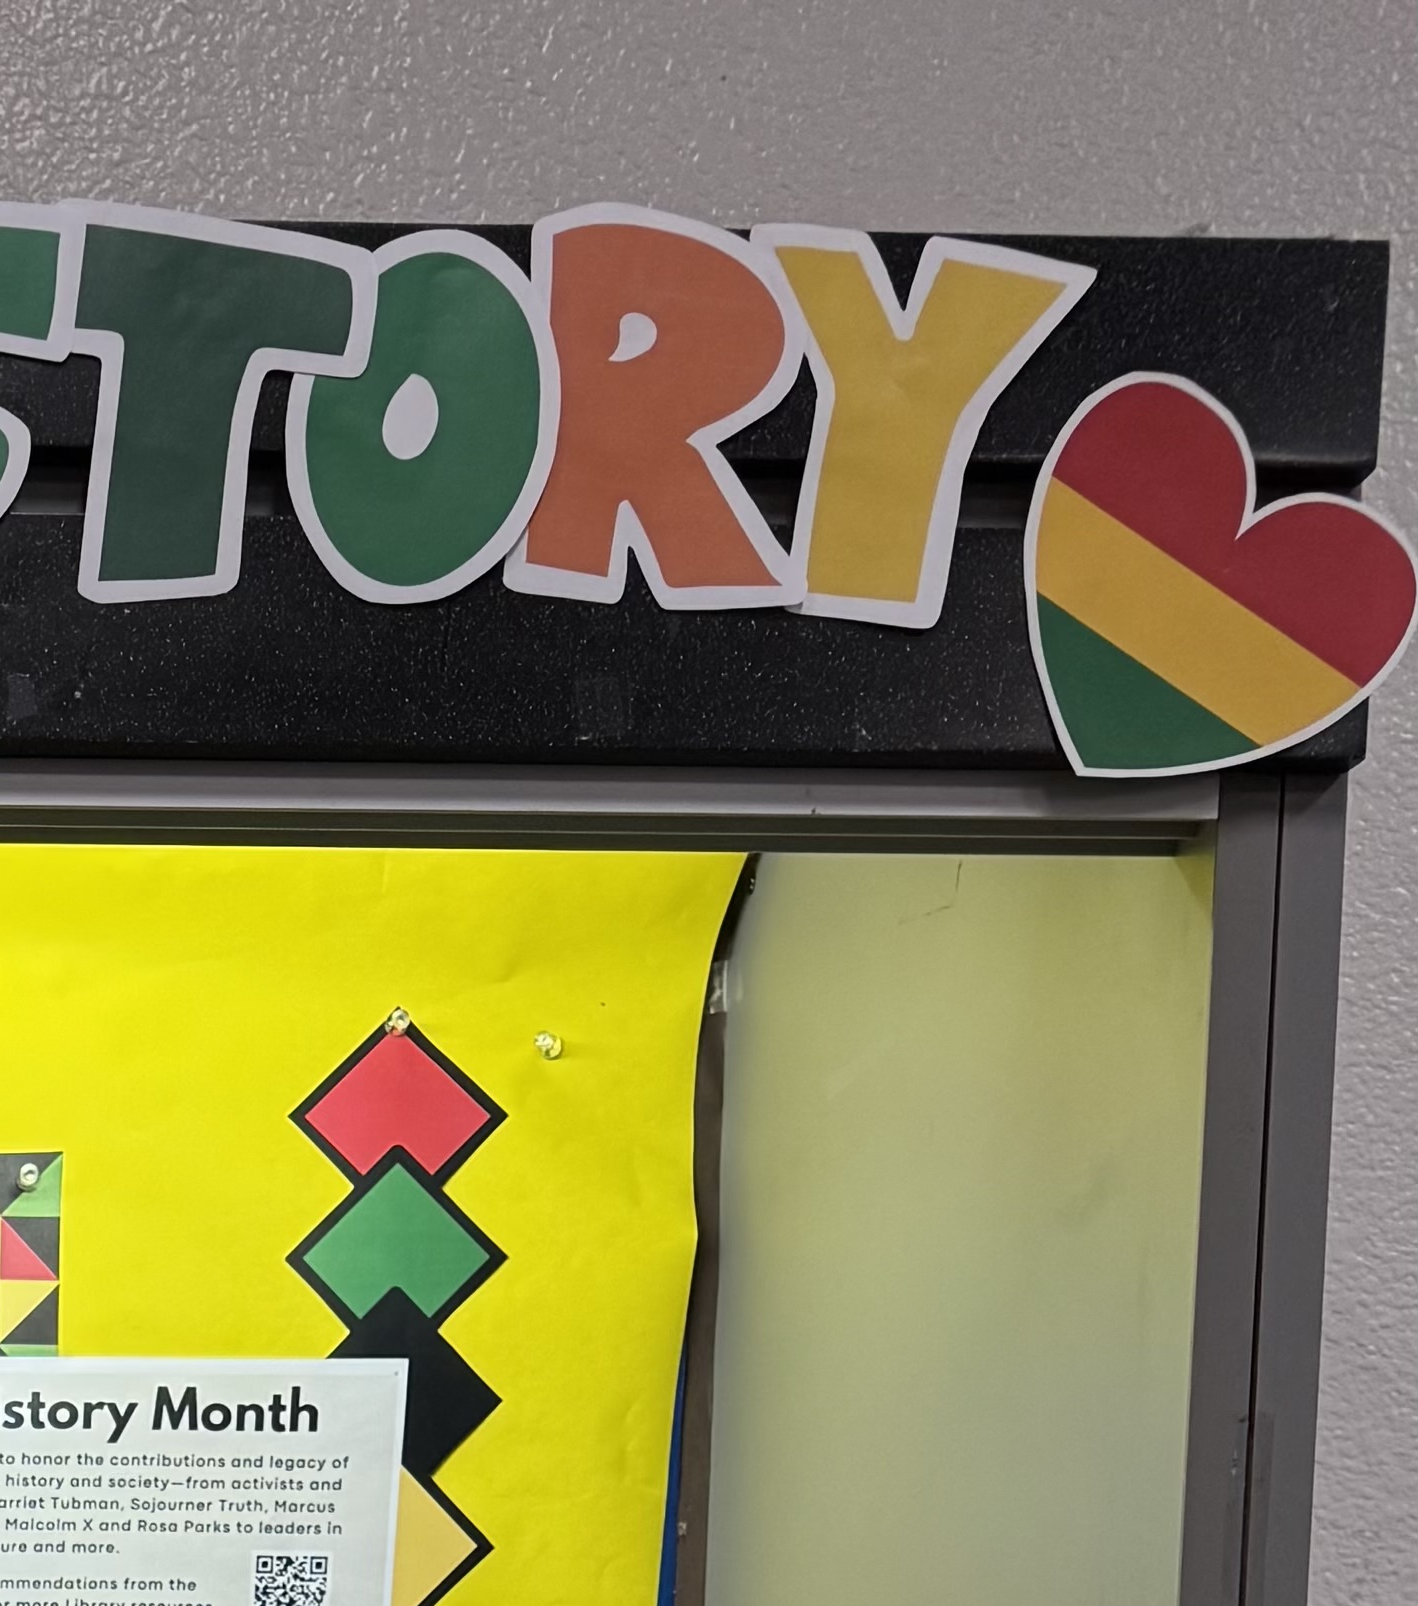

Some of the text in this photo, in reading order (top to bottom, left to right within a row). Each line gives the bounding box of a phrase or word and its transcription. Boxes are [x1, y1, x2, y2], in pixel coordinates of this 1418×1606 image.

[152, 1386, 318, 1433] Month
[21, 1452, 71, 1465] honor
[77, 1453, 104, 1466] the
[110, 1453, 225, 1468] contributions
[231, 1455, 264, 1468] and
[269, 1455, 326, 1472] legacy
[331, 1456, 349, 1469] of
